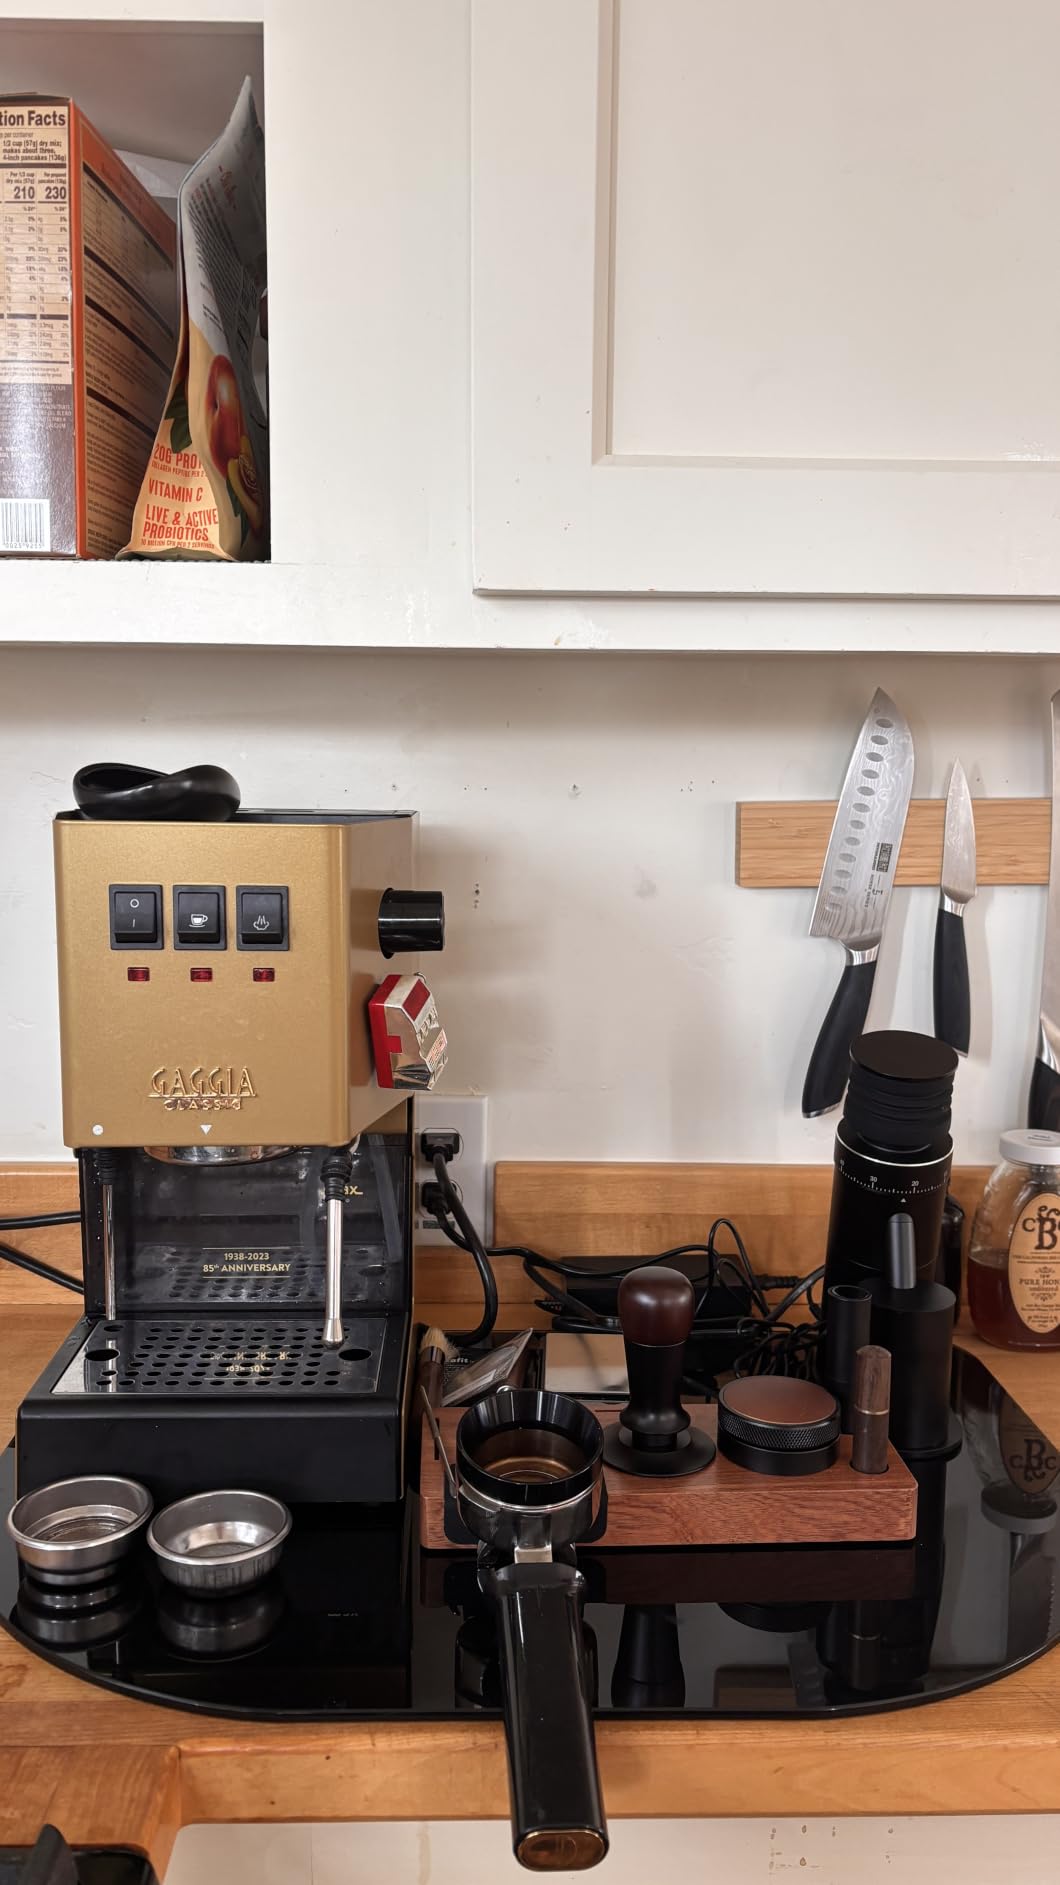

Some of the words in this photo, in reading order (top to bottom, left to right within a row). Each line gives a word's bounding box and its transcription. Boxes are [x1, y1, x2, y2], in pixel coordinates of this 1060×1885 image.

[27, 110, 66, 126] Facts
[14, 186, 35, 199] 210
[45, 186, 66, 199] 230
[154, 443, 172, 464] 20G
[148, 478, 193, 502] VITAMIN
[196, 487, 203, 502] C
[145, 504, 169, 525] LIVE
[172, 512, 181, 526] &
[185, 508, 219, 528] ACTIVE
[143, 521, 209, 542] PROBIOTICS
[150, 1066, 257, 1097] GAGGIA
[163, 1099, 242, 1110] CLASSIC
[224, 1253, 269, 1261] 1938-2023
[203, 1264, 219, 1272] 85th
[221, 1263, 291, 1272] ANNIVERSARY
